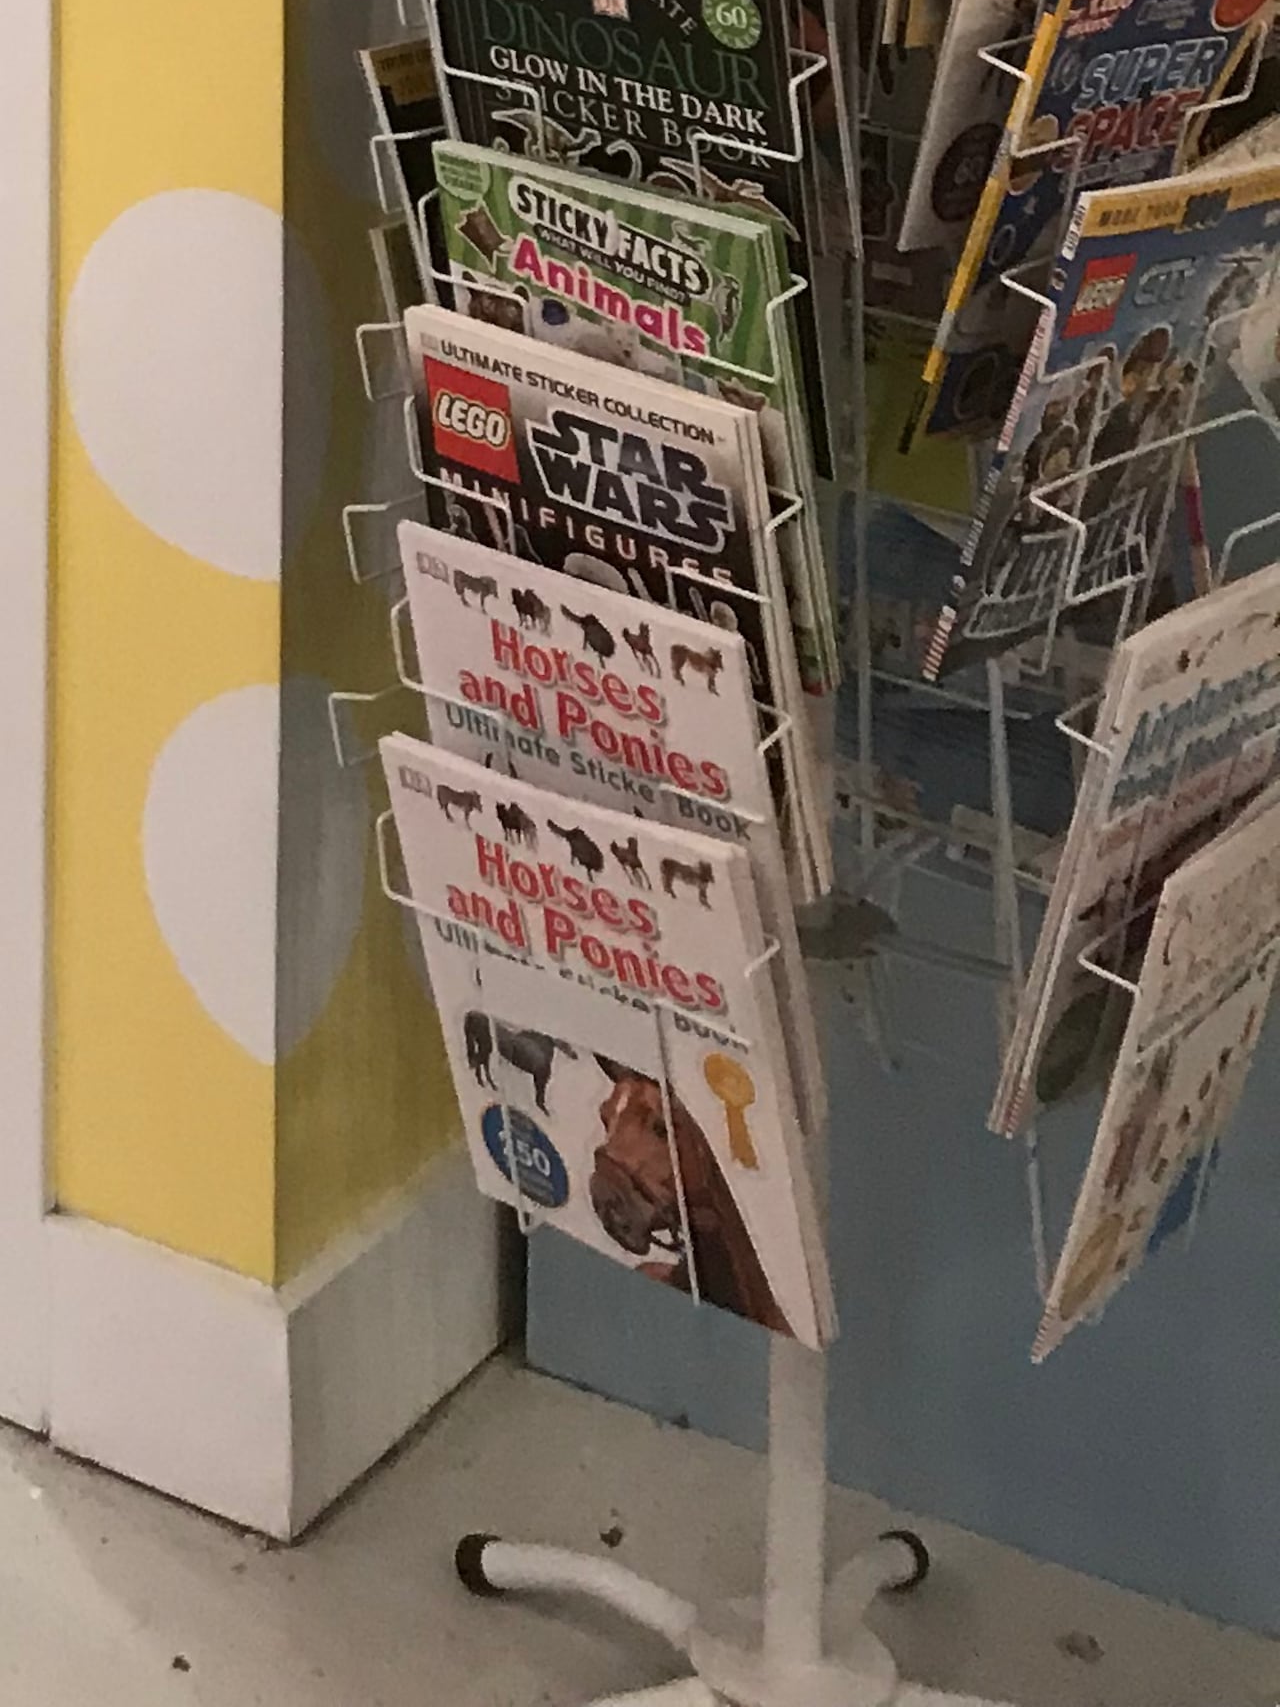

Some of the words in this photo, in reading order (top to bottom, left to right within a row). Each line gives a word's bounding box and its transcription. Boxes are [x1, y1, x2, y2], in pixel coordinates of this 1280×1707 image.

[715, 9, 747, 29] 60
[490, 45, 569, 85] GLOW
[576, 66, 610, 97] IN
[613, 77, 674, 113] THE
[680, 93, 767, 135] DARK
[1072, 36, 1228, 113] SUPER
[662, 117, 771, 169] BOOK
[516, 183, 609, 254] STICKY
[619, 228, 702, 291] FACTS
[614, 260, 644, 284] YOU
[512, 237, 708, 355] Animals
[440, 340, 523, 383] ULTIMATE
[527, 371, 599, 410] STICKER
[604, 396, 714, 446] COLLECTION
[436, 393, 510, 450] LEGO
[530, 409, 726, 505] STAR
[533, 447, 731, 550] WARS
[490, 617, 664, 725] Horses
[445, 702, 561, 766] Ultiate
[570, 751, 654, 803] Sticke
[458, 669, 540, 730] and
[554, 691, 729, 799] Ponies
[474, 834, 656, 936] Horses
[447, 884, 525, 941] and
[543, 909, 724, 1009] Ponies
[499, 1131, 551, 1176] 50
